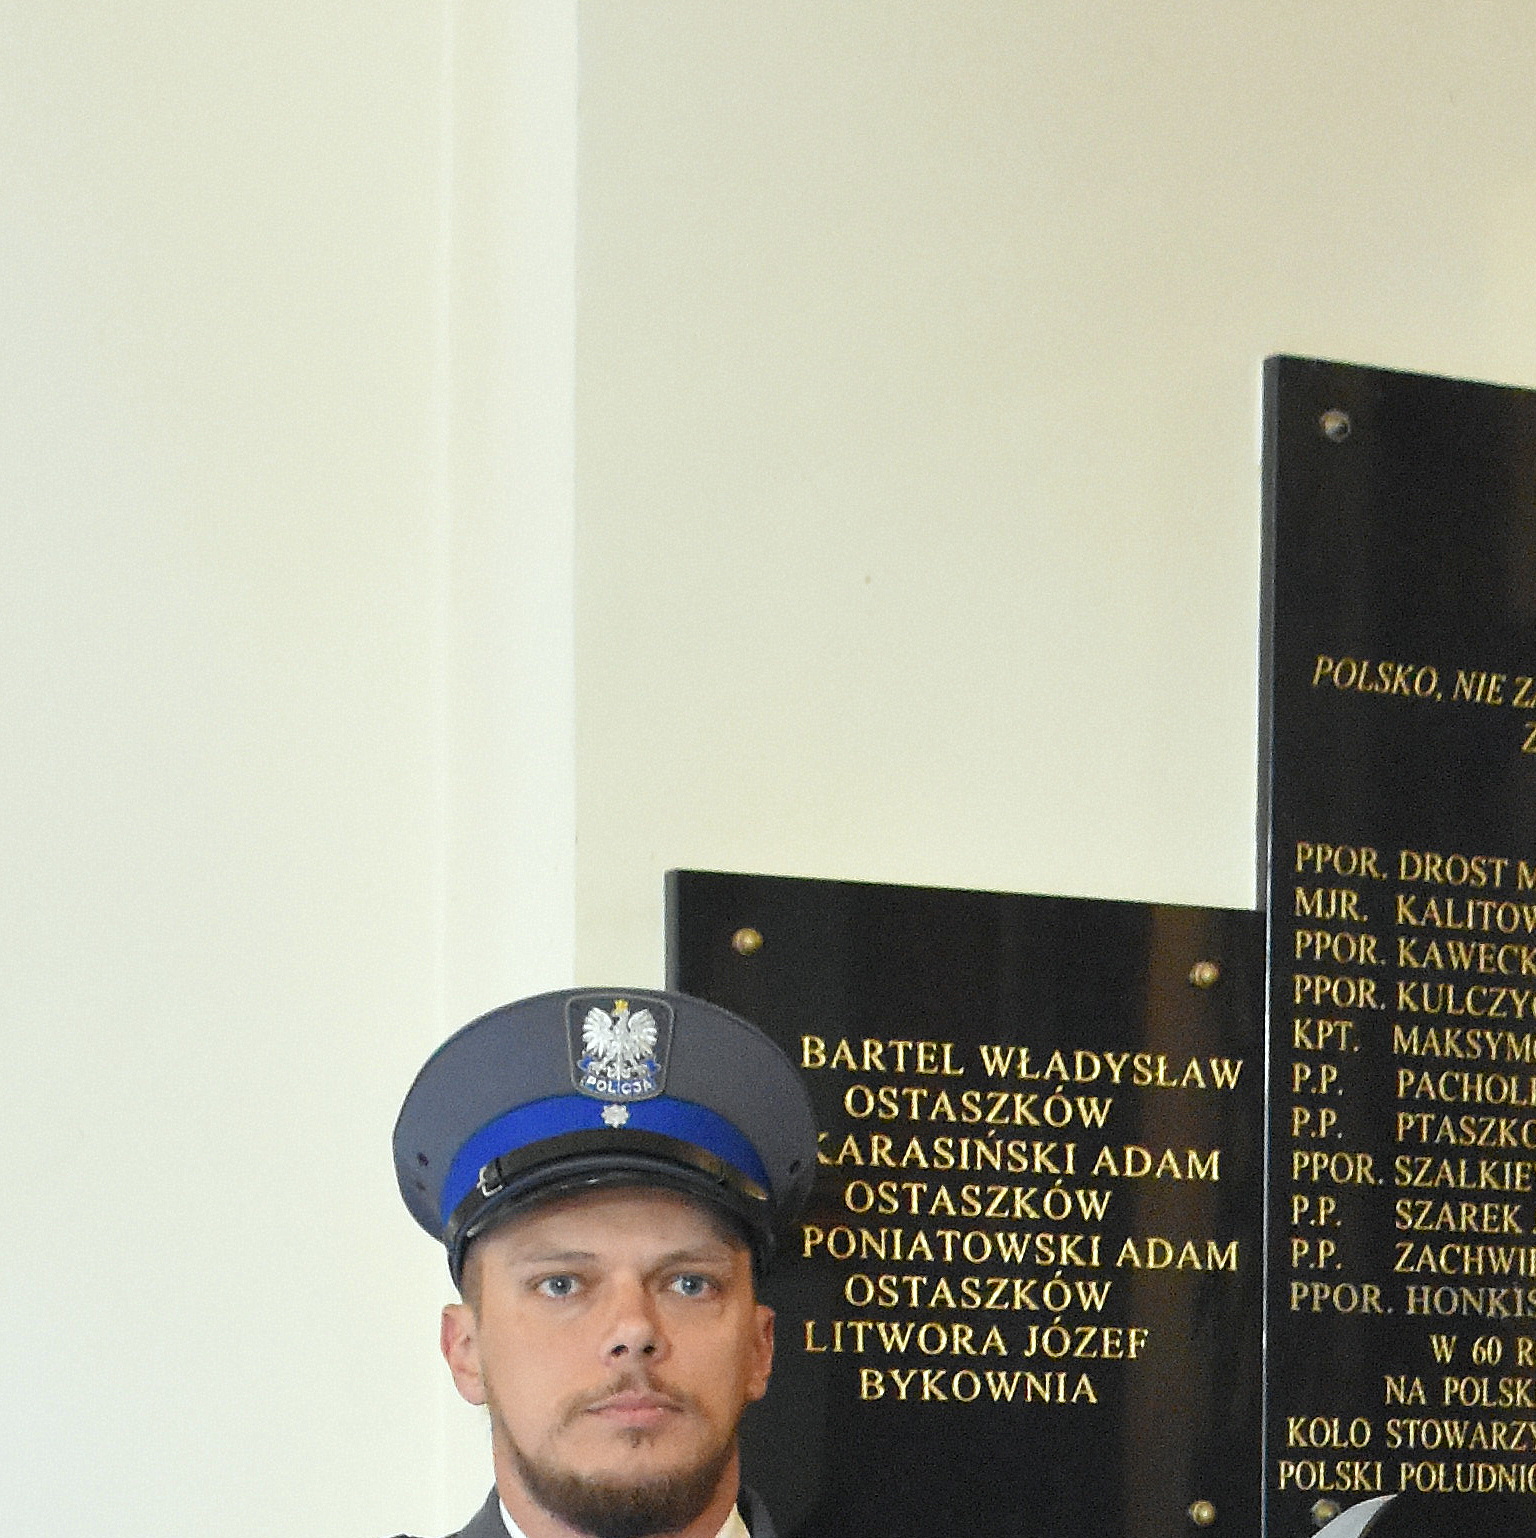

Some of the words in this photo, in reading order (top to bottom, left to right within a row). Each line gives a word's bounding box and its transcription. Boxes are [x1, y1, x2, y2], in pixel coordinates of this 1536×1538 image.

[1452, 669, 1506, 705] NIE
[1296, 840, 1387, 880] PPOR.
[1400, 850, 1508, 888] DROST
[1295, 886, 1368, 922] MJR.
[1295, 929, 1387, 965] PPOR.
[1294, 974, 1386, 1010] PPOR.
[1293, 1018, 1359, 1052] KPT.
[801, 1035, 963, 1077] BARTEL
[844, 1085, 1113, 1129] OSTASZKÓW
[1092, 1145, 1221, 1182] ADAM
[1292, 1151, 1384, 1185] PPOR.
[844, 1179, 1112, 1222] OSTASZKÓW
[1395, 1200, 1522, 1234] SZAREK
[802, 1226, 1102, 1269] PONIATOWSKI
[1117, 1240, 1239, 1272] ADAM
[844, 1272, 1112, 1313] OSTASZKÓW
[1290, 1281, 1393, 1314] PPOR.
[803, 1319, 1009, 1358] LITWORA
[1024, 1317, 1149, 1361] JÓZEF
[1430, 1334, 1457, 1366] W
[1472, 1336, 1502, 1366] 60
[859, 1368, 1098, 1405] BYKOWNIA
[1384, 1375, 1427, 1405] NA
[1277, 1459, 1384, 1491] POLSKI
